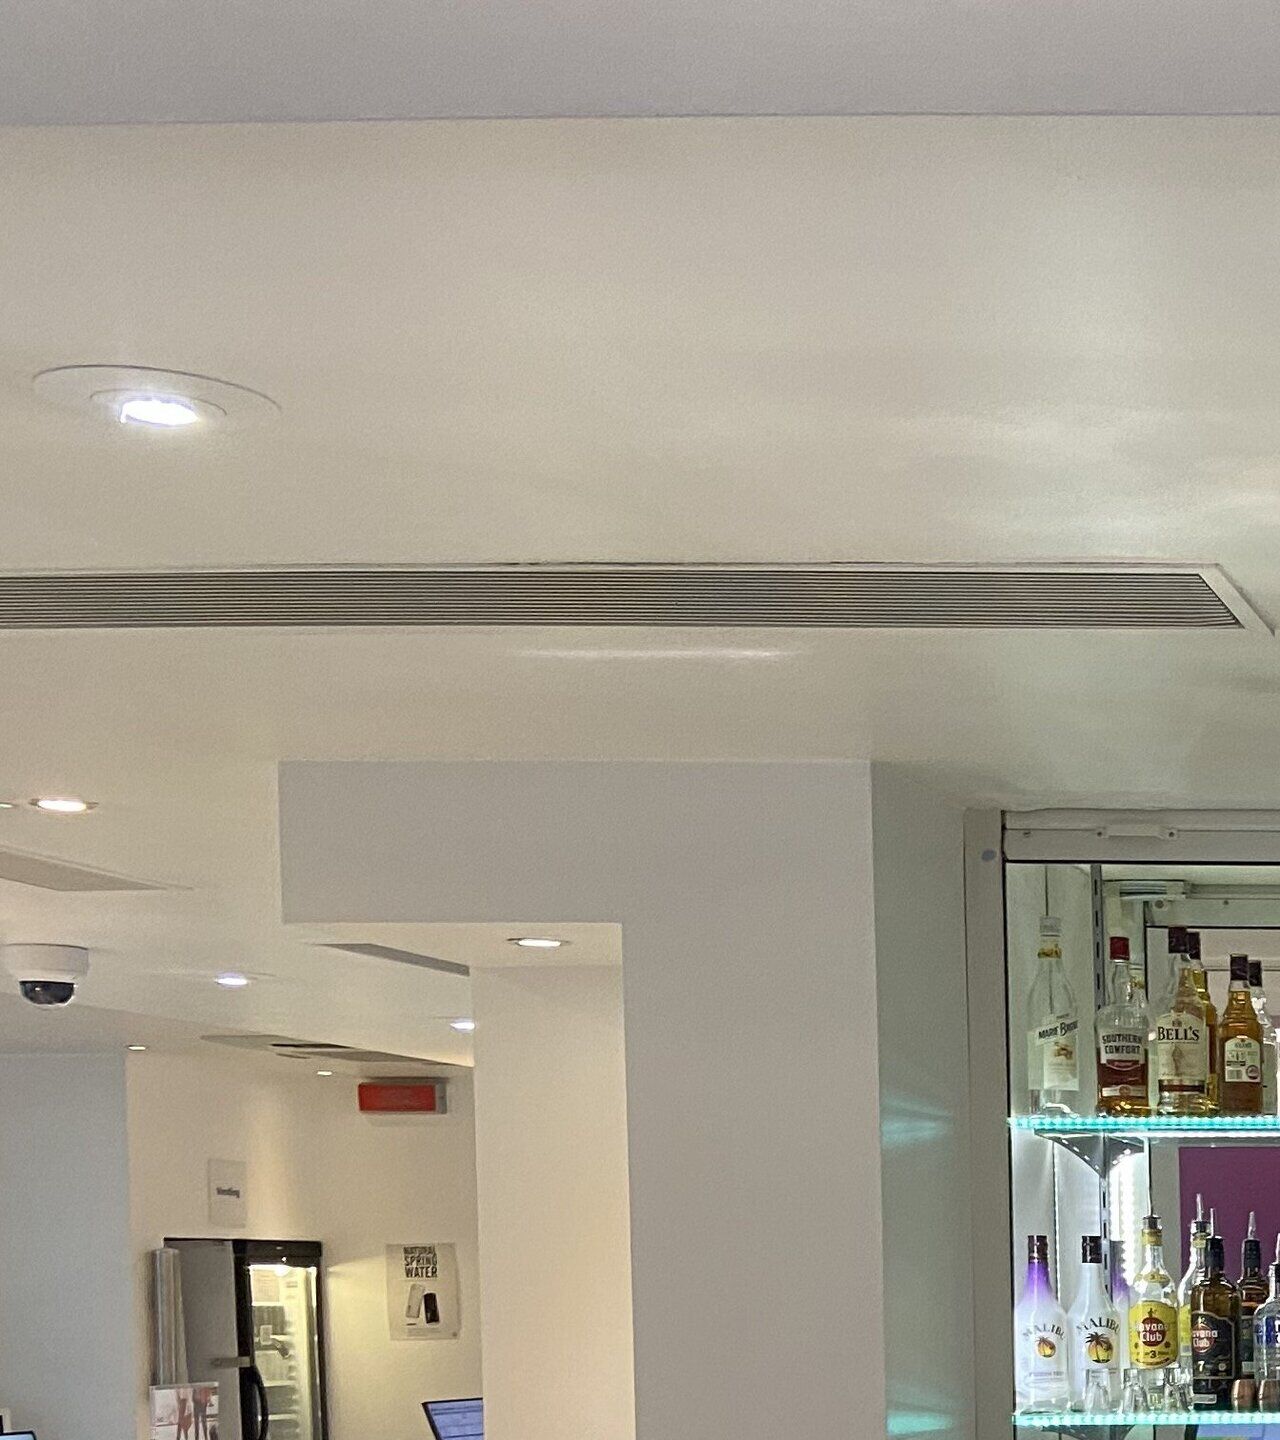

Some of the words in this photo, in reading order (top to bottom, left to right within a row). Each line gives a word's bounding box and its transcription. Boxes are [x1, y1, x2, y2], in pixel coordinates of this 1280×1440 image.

[1101, 1033, 1143, 1044] SOUTHERN
[1157, 1026, 1200, 1041] BELL'S
[1104, 1044, 1141, 1054] COMFORT
[404, 1254, 438, 1267] SPRING
[404, 1266, 438, 1279] WATER
[1139, 1331, 1163, 1342] Club
